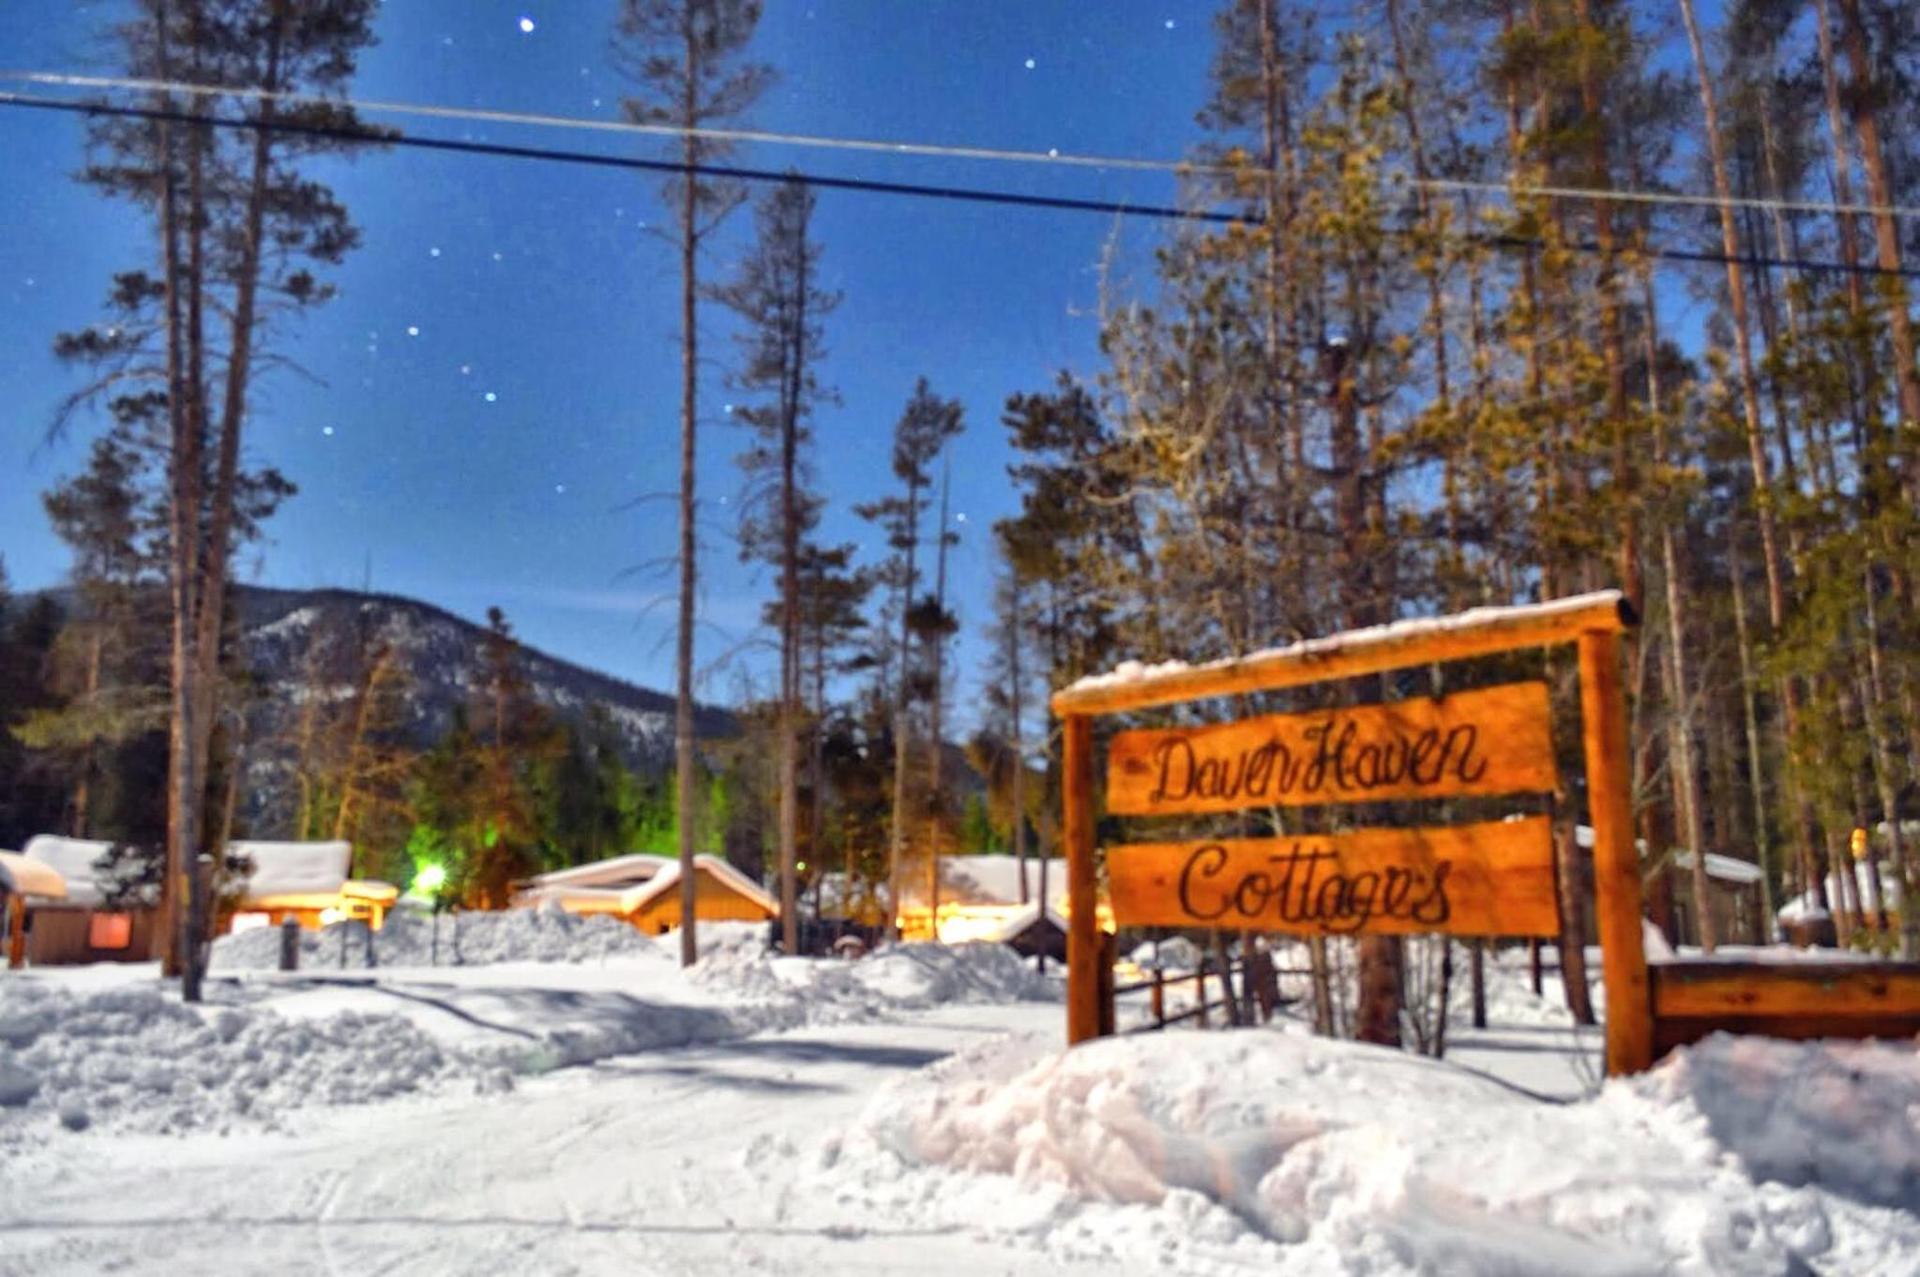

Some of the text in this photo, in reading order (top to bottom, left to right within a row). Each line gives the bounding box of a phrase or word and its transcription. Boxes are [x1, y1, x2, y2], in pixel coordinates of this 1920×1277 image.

[1150, 720, 1488, 804] Daven Haven
[1178, 843, 1453, 934] Cottages
